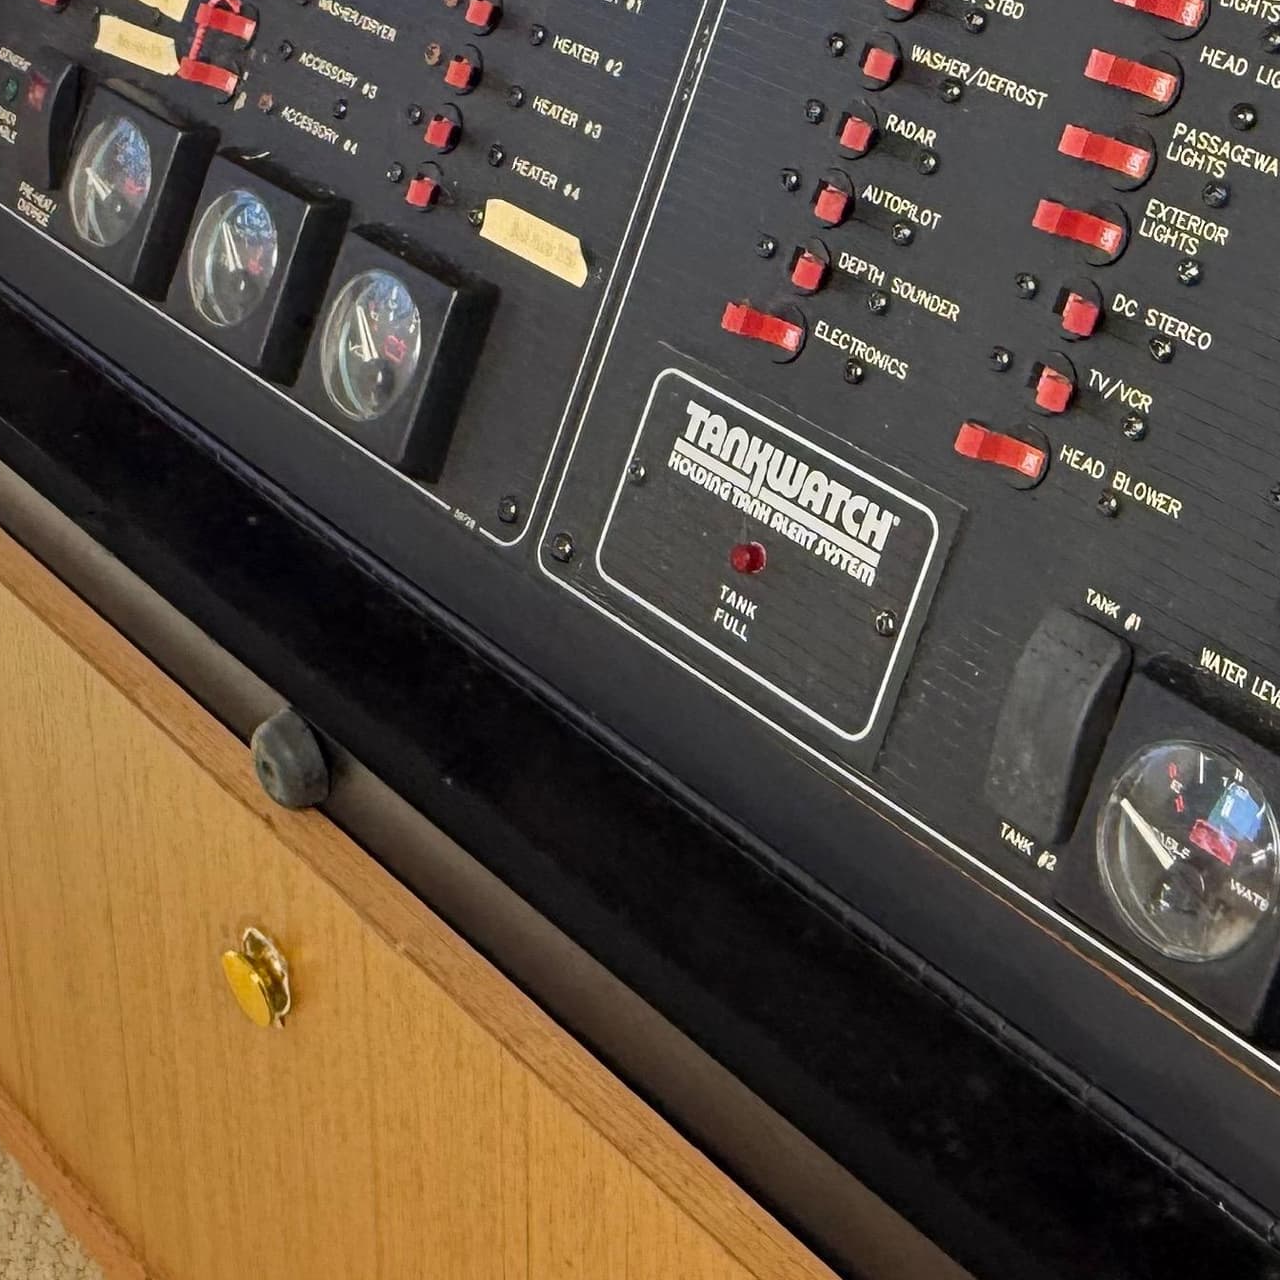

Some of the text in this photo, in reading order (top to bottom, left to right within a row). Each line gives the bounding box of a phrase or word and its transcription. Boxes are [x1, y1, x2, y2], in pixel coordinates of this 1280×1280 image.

[911, 44, 1049, 111] WASHER/DEFROST
[1199, 45, 1249, 77] HEAD
[885, 113, 937, 149] RADAR
[1166, 142, 1228, 179] LIGHTS
[861, 184, 943, 231] AUTOPILOT
[1145, 198, 1230, 246] EXTERIOR
[1138, 218, 1200, 256] LIGHTS
[838, 251, 961, 323] DEPTH SOUNDER
[1111, 293, 1212, 351] DC STEREO
[814, 320, 910, 381] ELECTRONICS
[1088, 368, 1153, 414] TV/VCR
[686, 399, 894, 552] TANKWATCH
[1059, 444, 1183, 520] HEAD BLOWER
[667, 450, 877, 588] HOLDING TANK ALERT SYSTEM
[720, 584, 759, 620] TANK
[1086, 588, 1120, 619] TANK
[712, 608, 750, 643] FULL
[1199, 647, 1247, 690] WATER
[999, 821, 1034, 857] TANK
